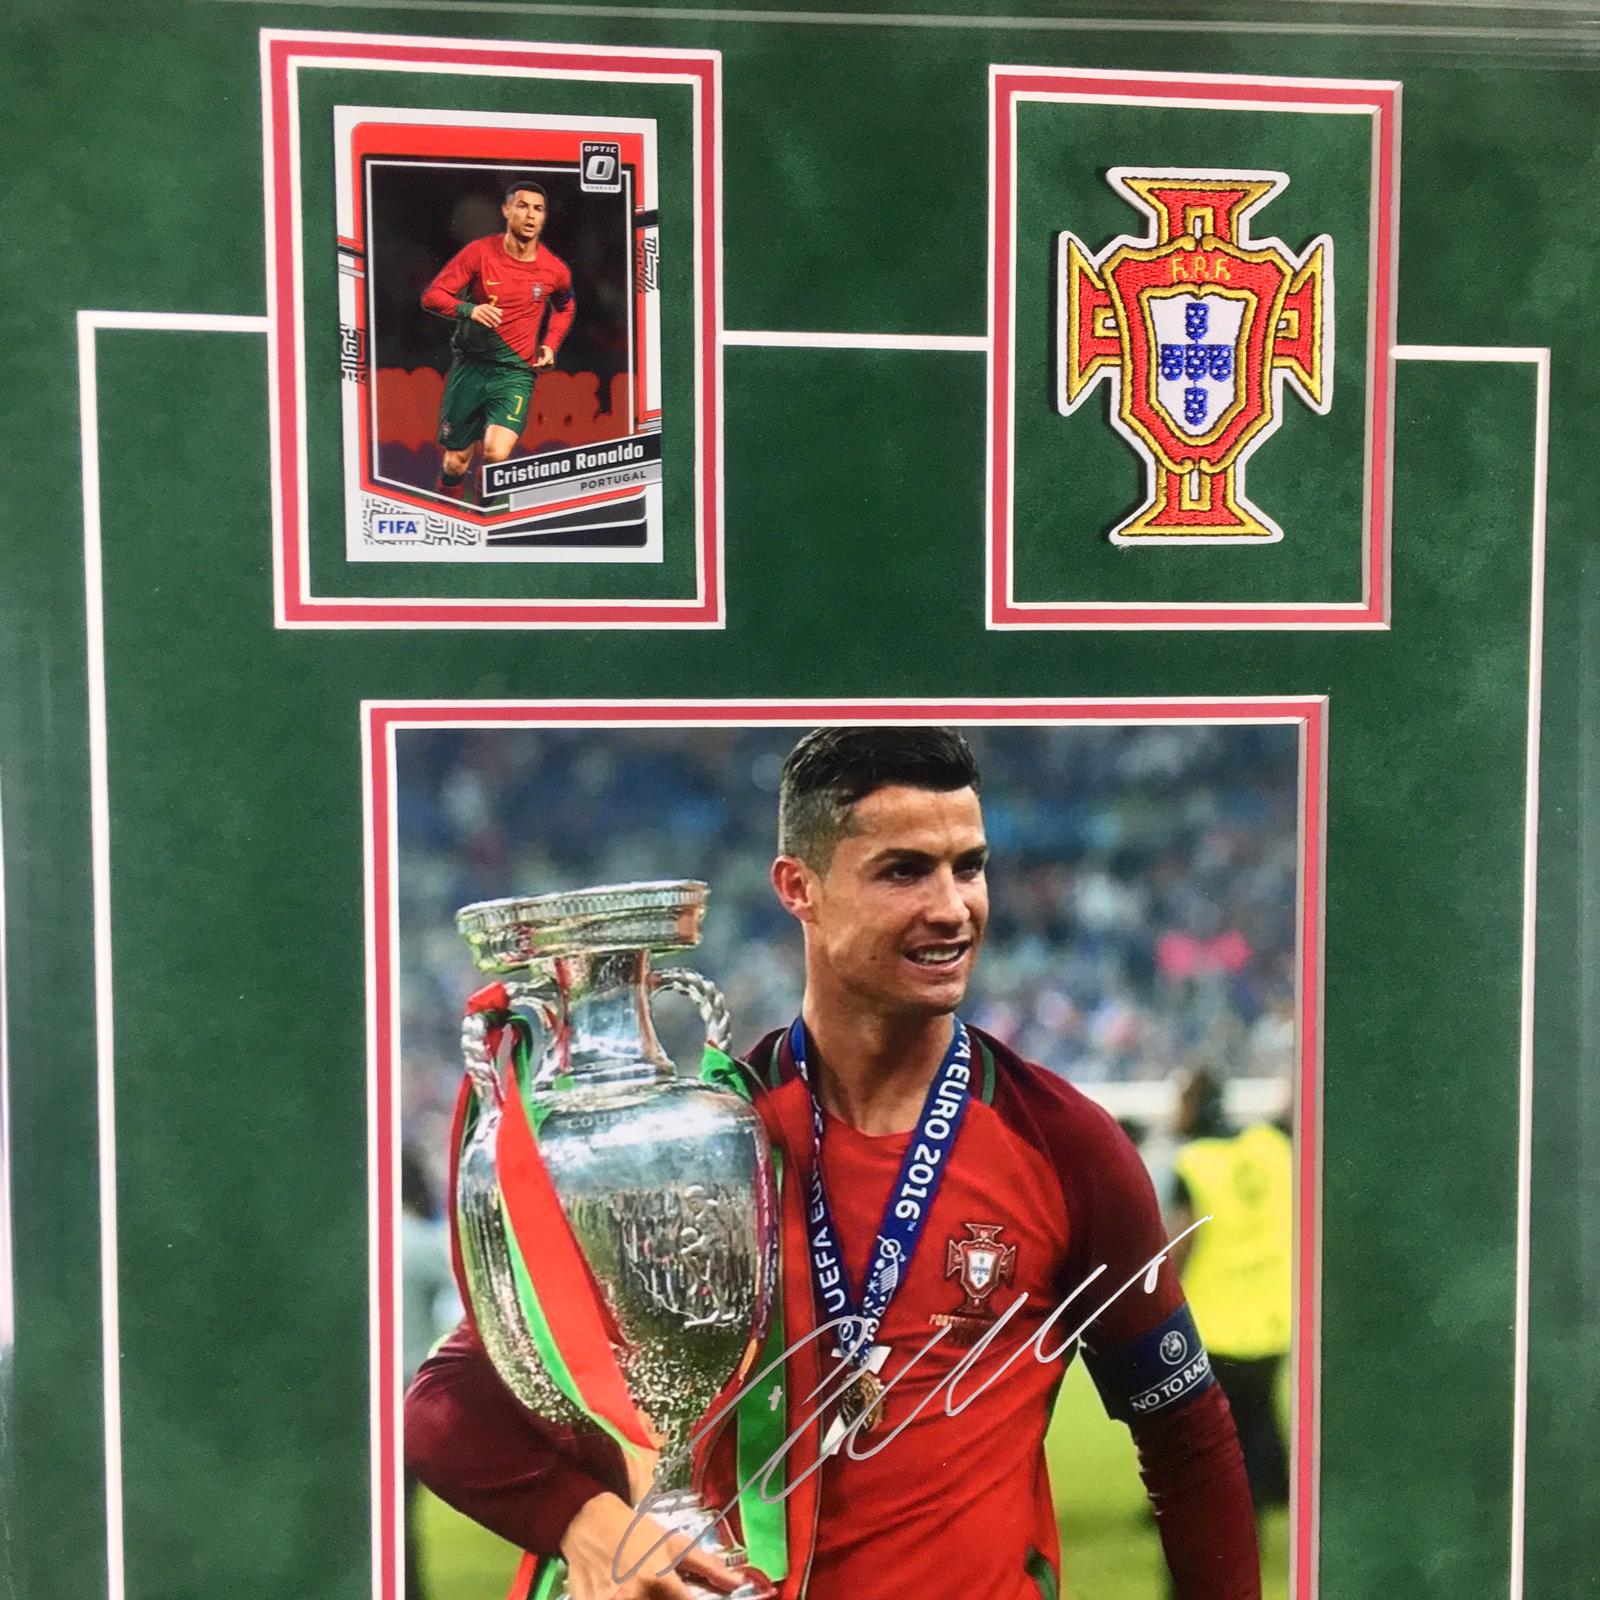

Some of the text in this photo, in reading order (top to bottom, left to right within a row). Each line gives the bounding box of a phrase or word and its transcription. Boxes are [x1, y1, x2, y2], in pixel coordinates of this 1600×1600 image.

[584, 145, 618, 153] OPTIC
[514, 395, 524, 416] 7
[493, 442, 645, 487] Cristiano Ronaldo
[580, 470, 647, 491] PORTUGAL
[378, 520, 418, 535] FIFA
[923, 1063, 972, 1141] EURO
[894, 1143, 942, 1220] 2016
[813, 1225, 847, 1313] UEFA
[1132, 1393, 1160, 1411] NO
[1160, 1377, 1184, 1397] TO
